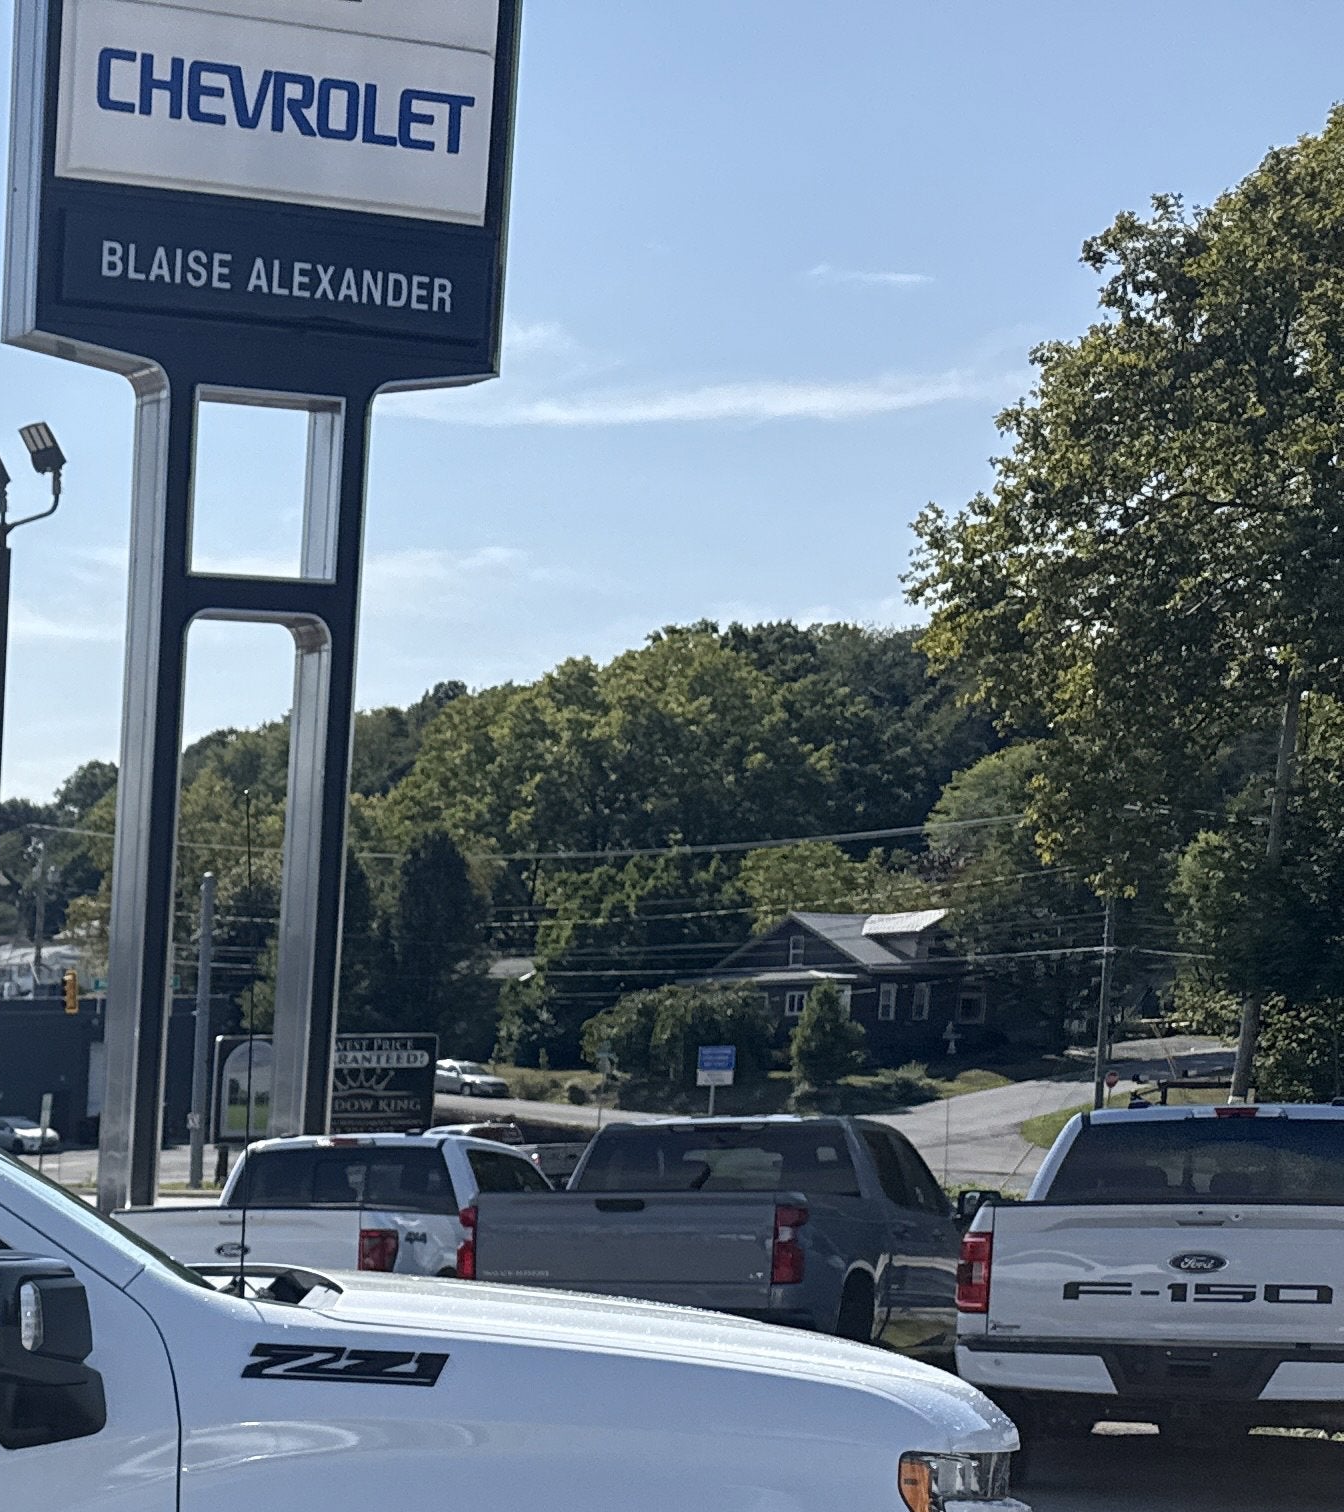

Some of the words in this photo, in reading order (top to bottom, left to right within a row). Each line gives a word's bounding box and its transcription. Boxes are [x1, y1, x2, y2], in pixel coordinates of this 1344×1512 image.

[96, 46, 476, 155] CHEVROLET
[100, 239, 232, 290] BLAISE
[246, 256, 453, 313] ALEXANDER
[378, 1099, 422, 1113] KING
[1180, 1256, 1215, 1269] Ford
[1063, 1281, 1334, 1305] F-150
[241, 1342, 451, 1387] Z71
